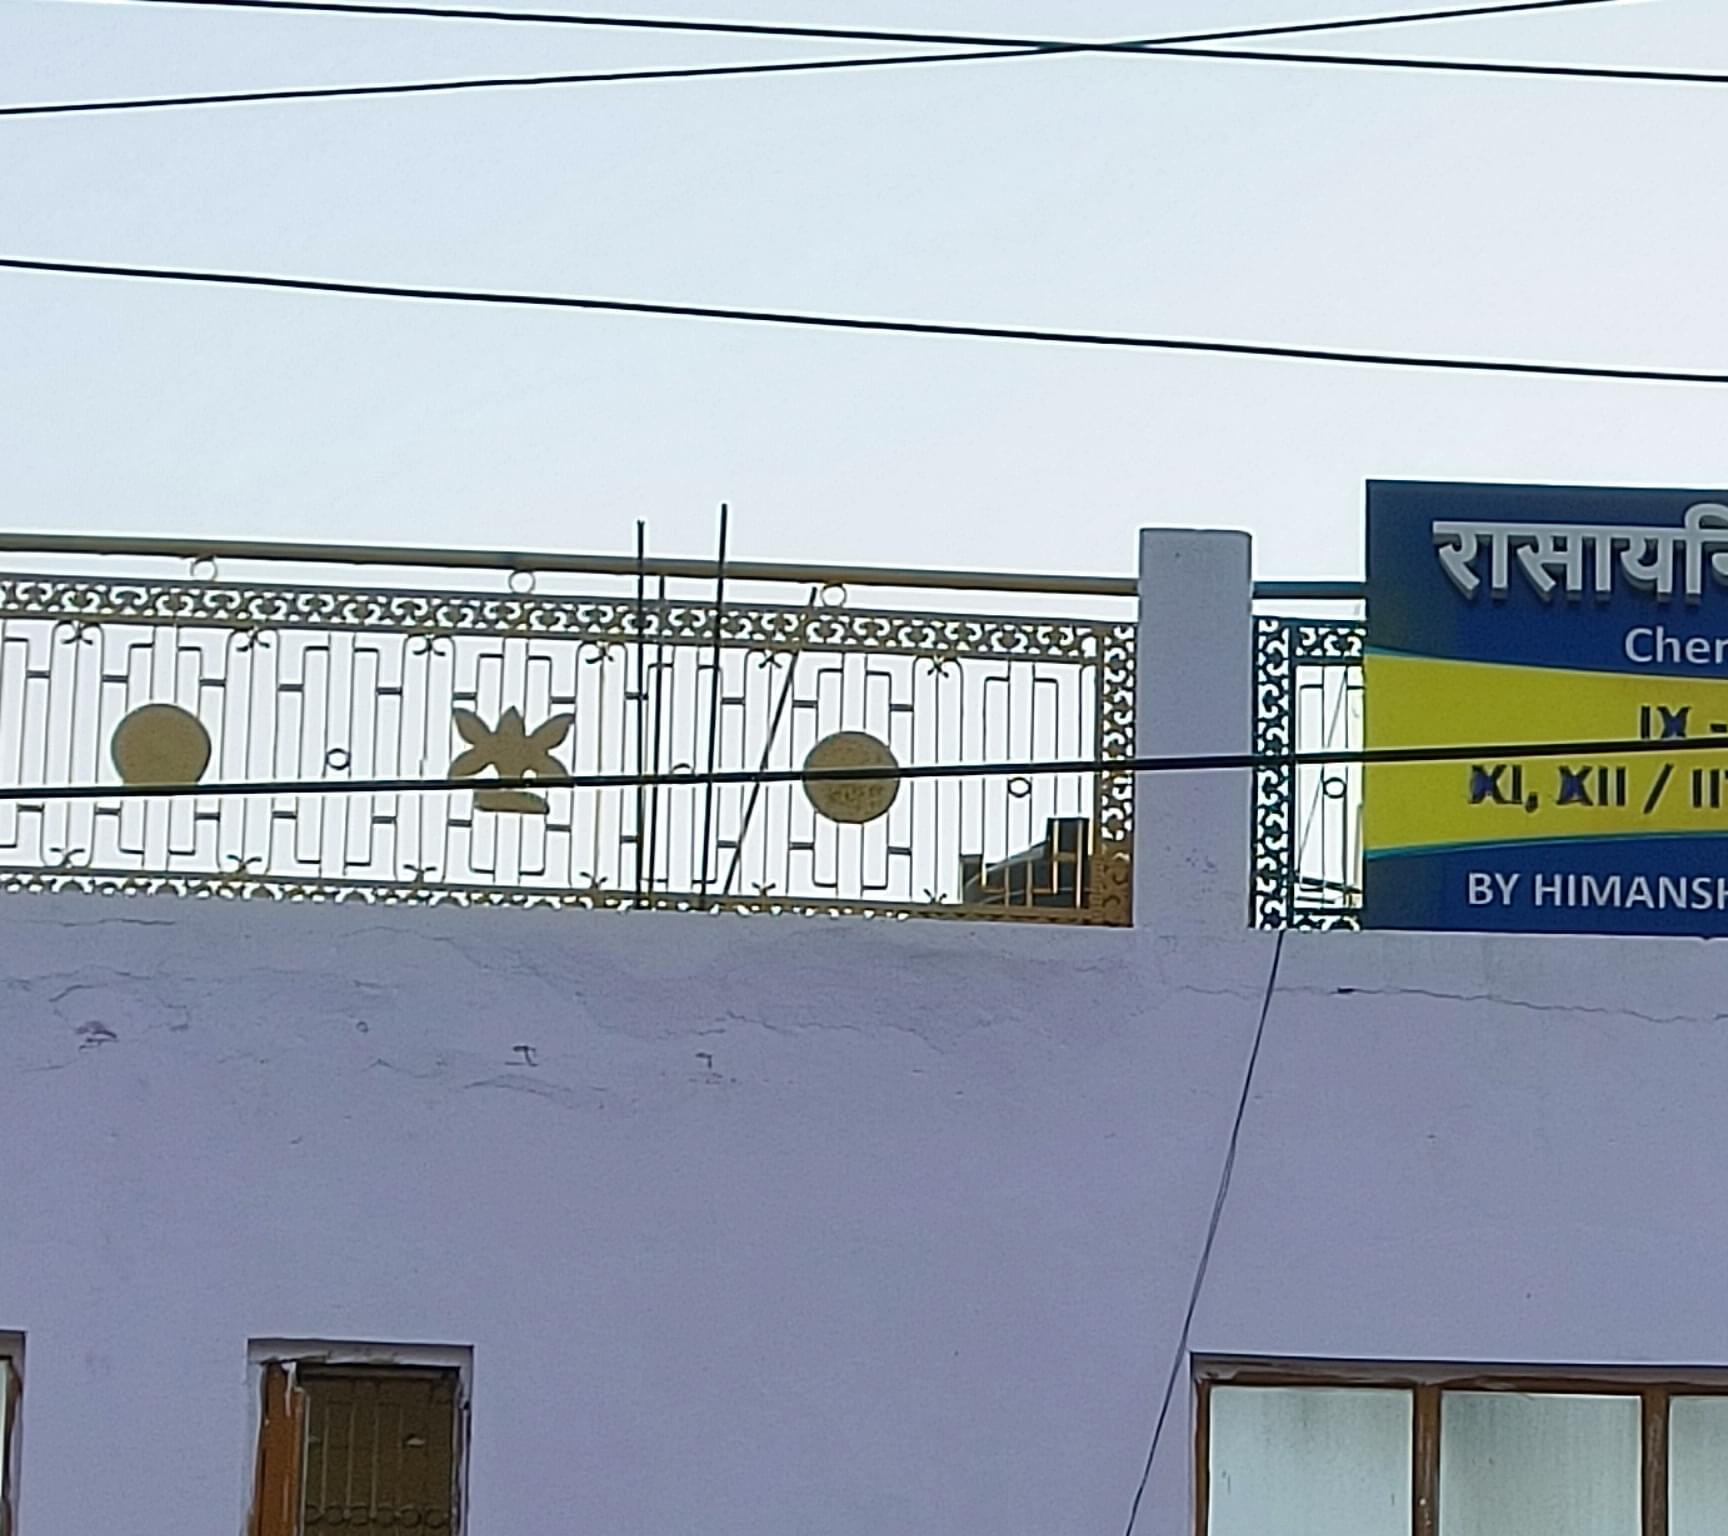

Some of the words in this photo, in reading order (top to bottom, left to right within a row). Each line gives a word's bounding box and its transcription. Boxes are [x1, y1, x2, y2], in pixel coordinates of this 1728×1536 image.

[1640, 705, 1691, 741] IX
[1469, 763, 1538, 813] XI,
[1557, 766, 1626, 807] XII
[1643, 763, 1674, 814] /
[1468, 873, 1519, 906] BY
